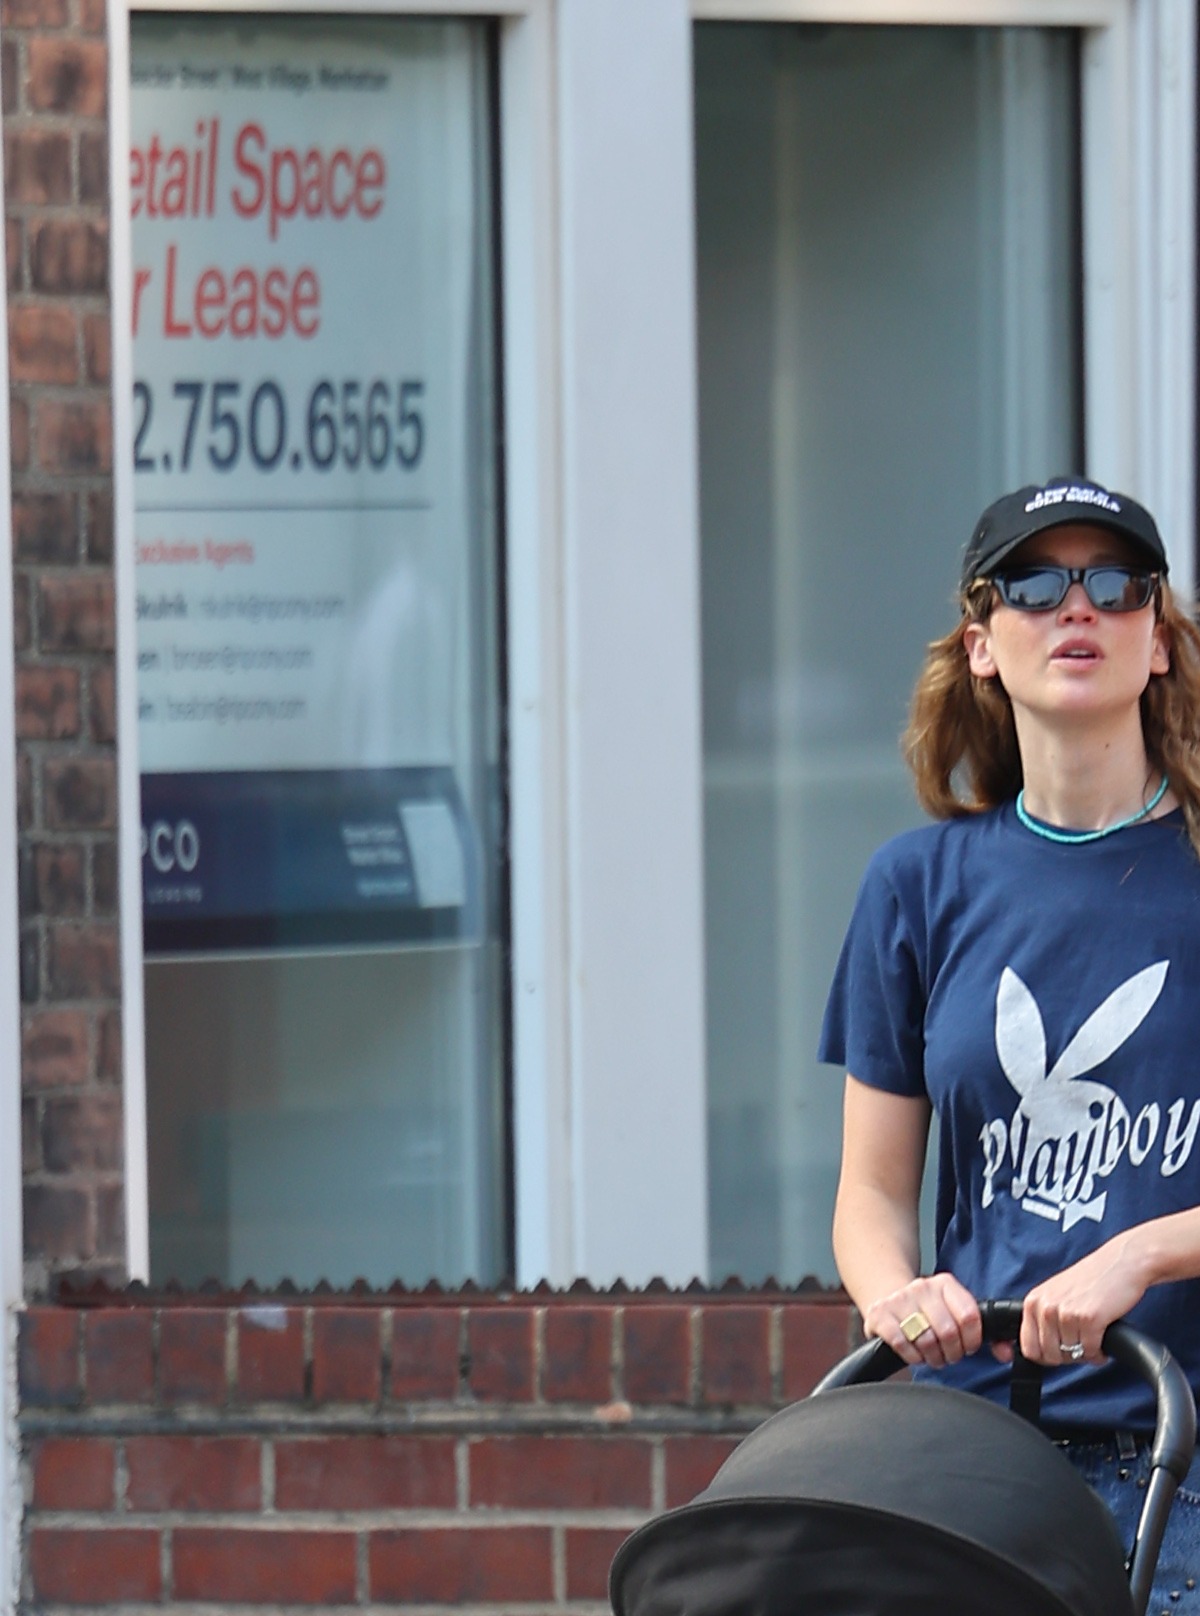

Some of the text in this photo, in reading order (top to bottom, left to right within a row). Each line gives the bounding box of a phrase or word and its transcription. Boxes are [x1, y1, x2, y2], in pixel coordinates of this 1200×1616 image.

[231, 122, 386, 242] Space
[163, 244, 321, 340] Lease
[134, 380, 426, 473] 2.750.6565
